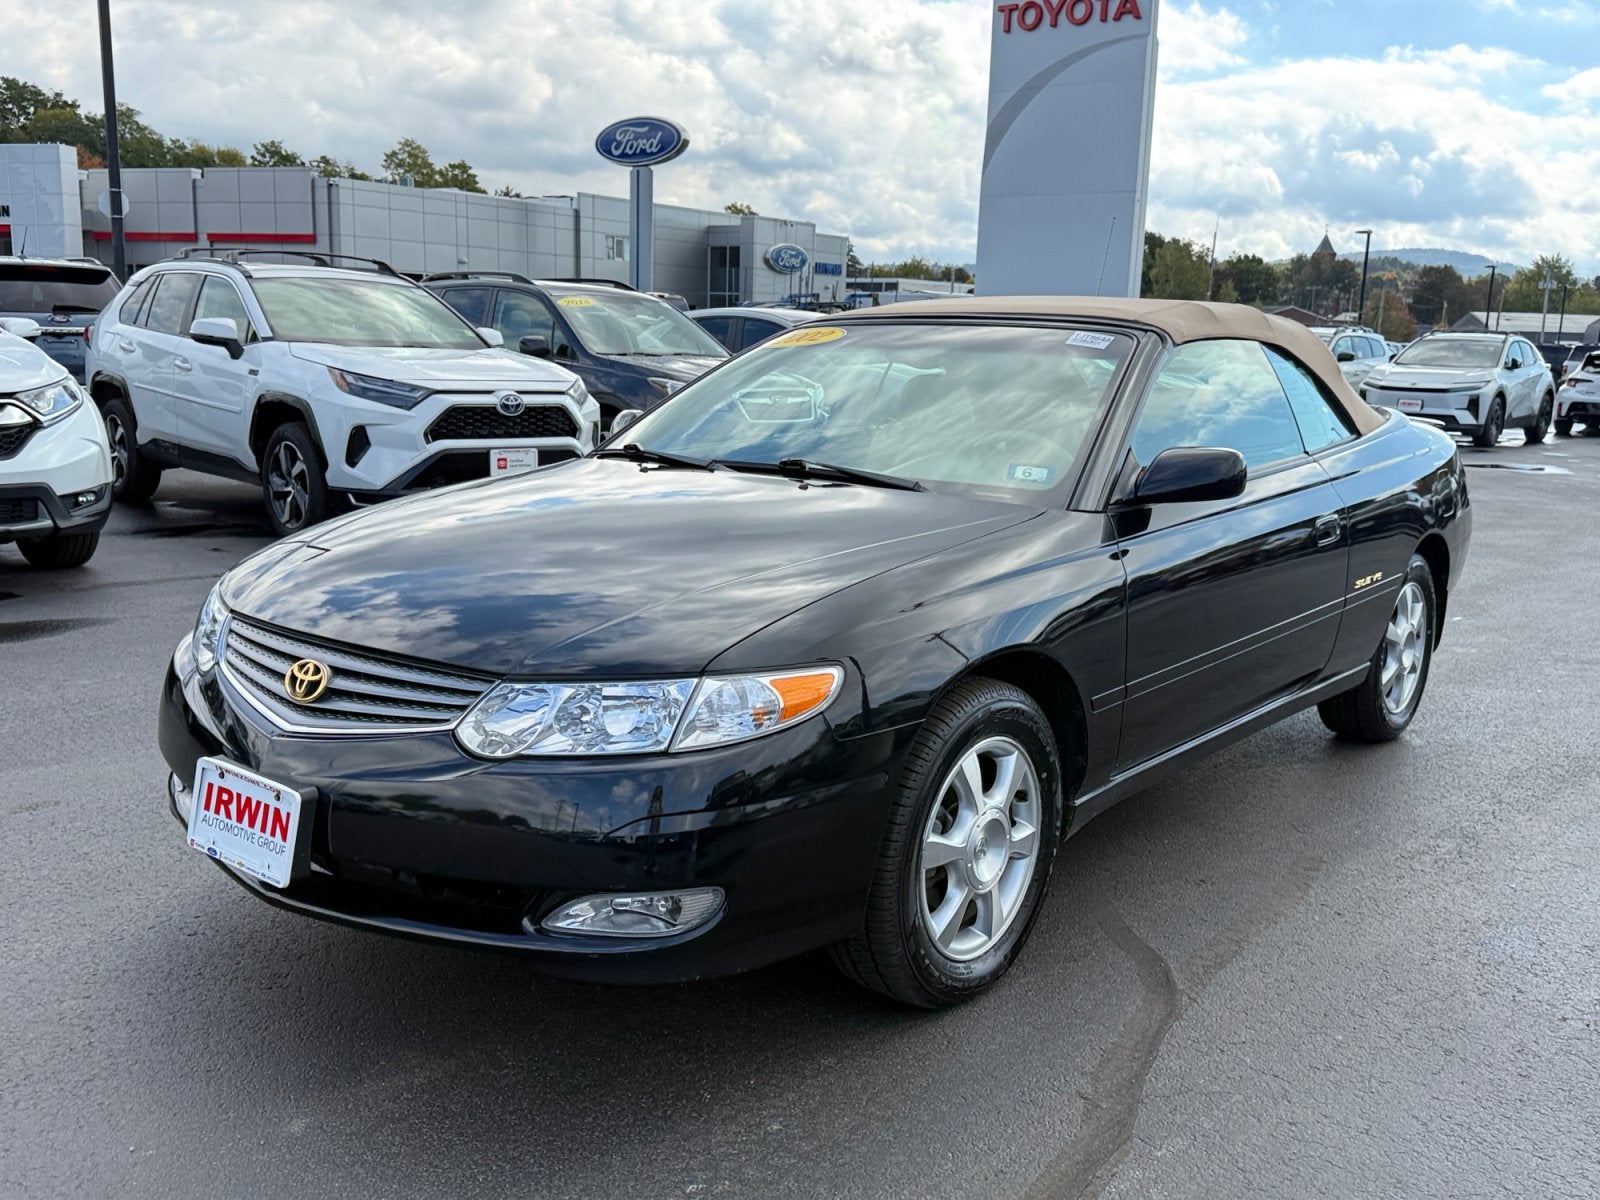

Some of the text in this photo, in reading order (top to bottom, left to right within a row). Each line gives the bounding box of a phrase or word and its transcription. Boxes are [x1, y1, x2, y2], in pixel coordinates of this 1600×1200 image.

[998, 0, 1142, 33] TOYOTA
[611, 126, 662, 156] Ford
[778, 249, 803, 268] Ford
[1022, 467, 1033, 478] 6
[203, 781, 291, 843] IRWIN
[201, 813, 257, 845] AUTOMOTIVE
